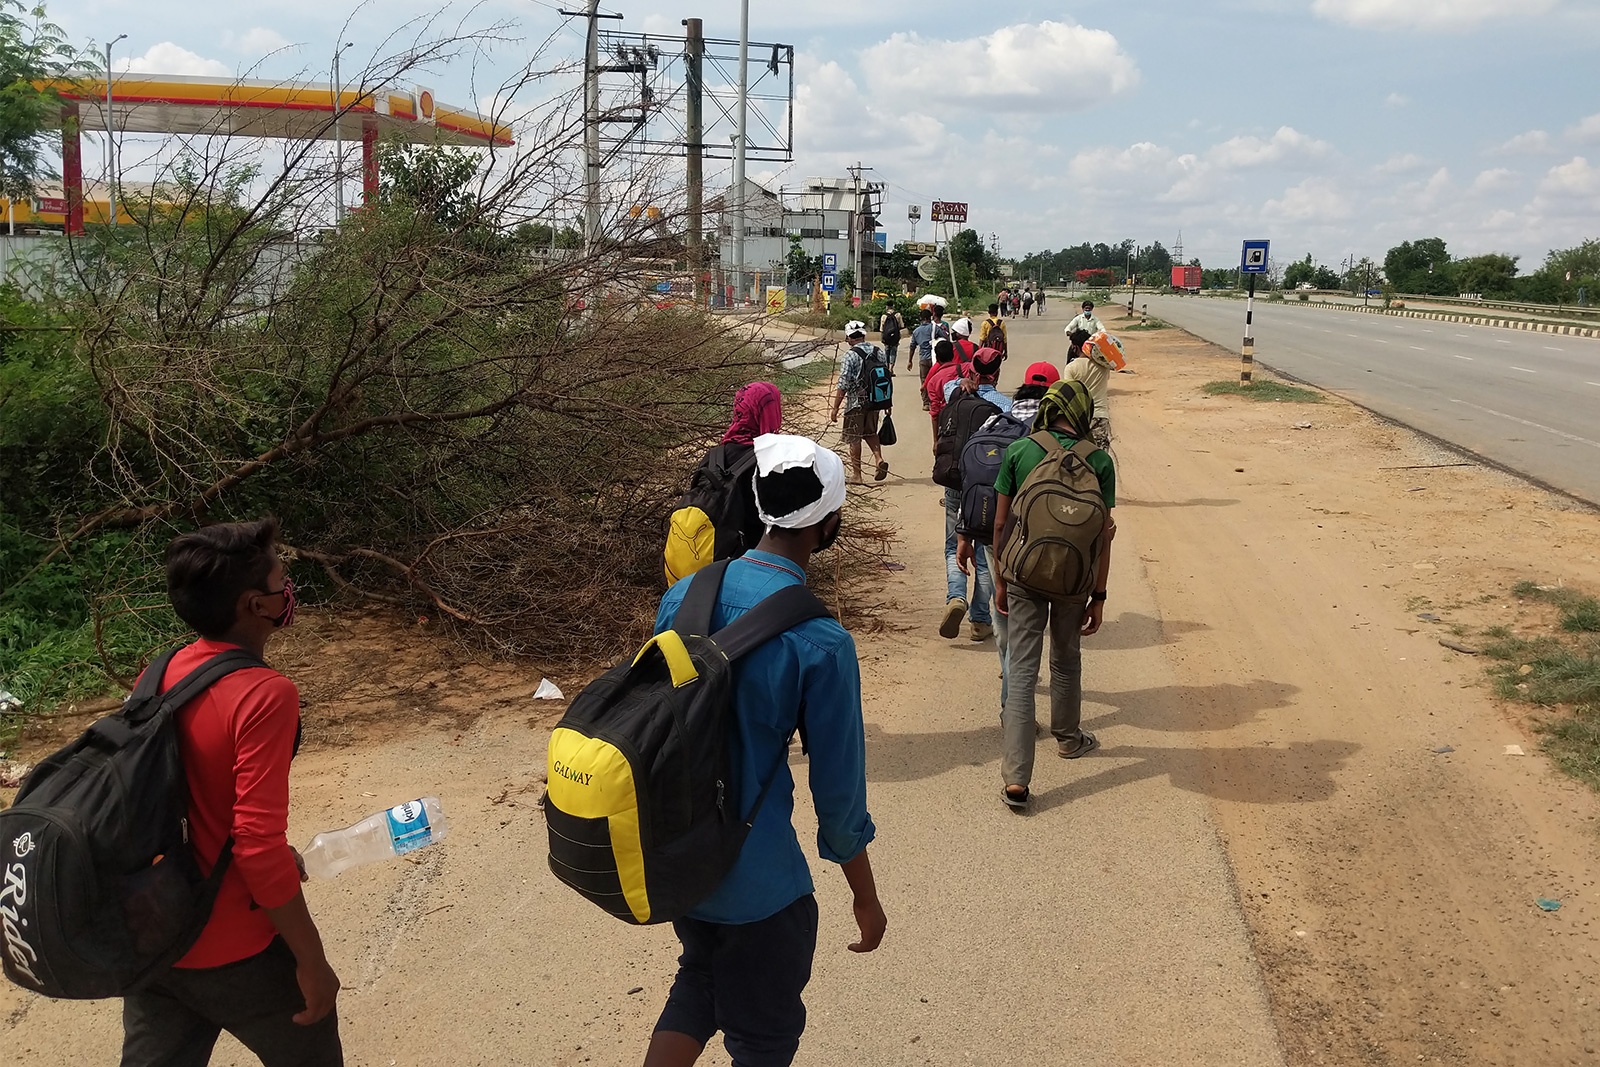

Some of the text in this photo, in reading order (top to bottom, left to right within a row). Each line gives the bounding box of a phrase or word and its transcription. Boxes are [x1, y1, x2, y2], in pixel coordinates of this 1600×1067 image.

[932, 202, 967, 213] GAGAN
[553, 760, 593, 786] GALWAY
[0, 862, 45, 986] Rider
